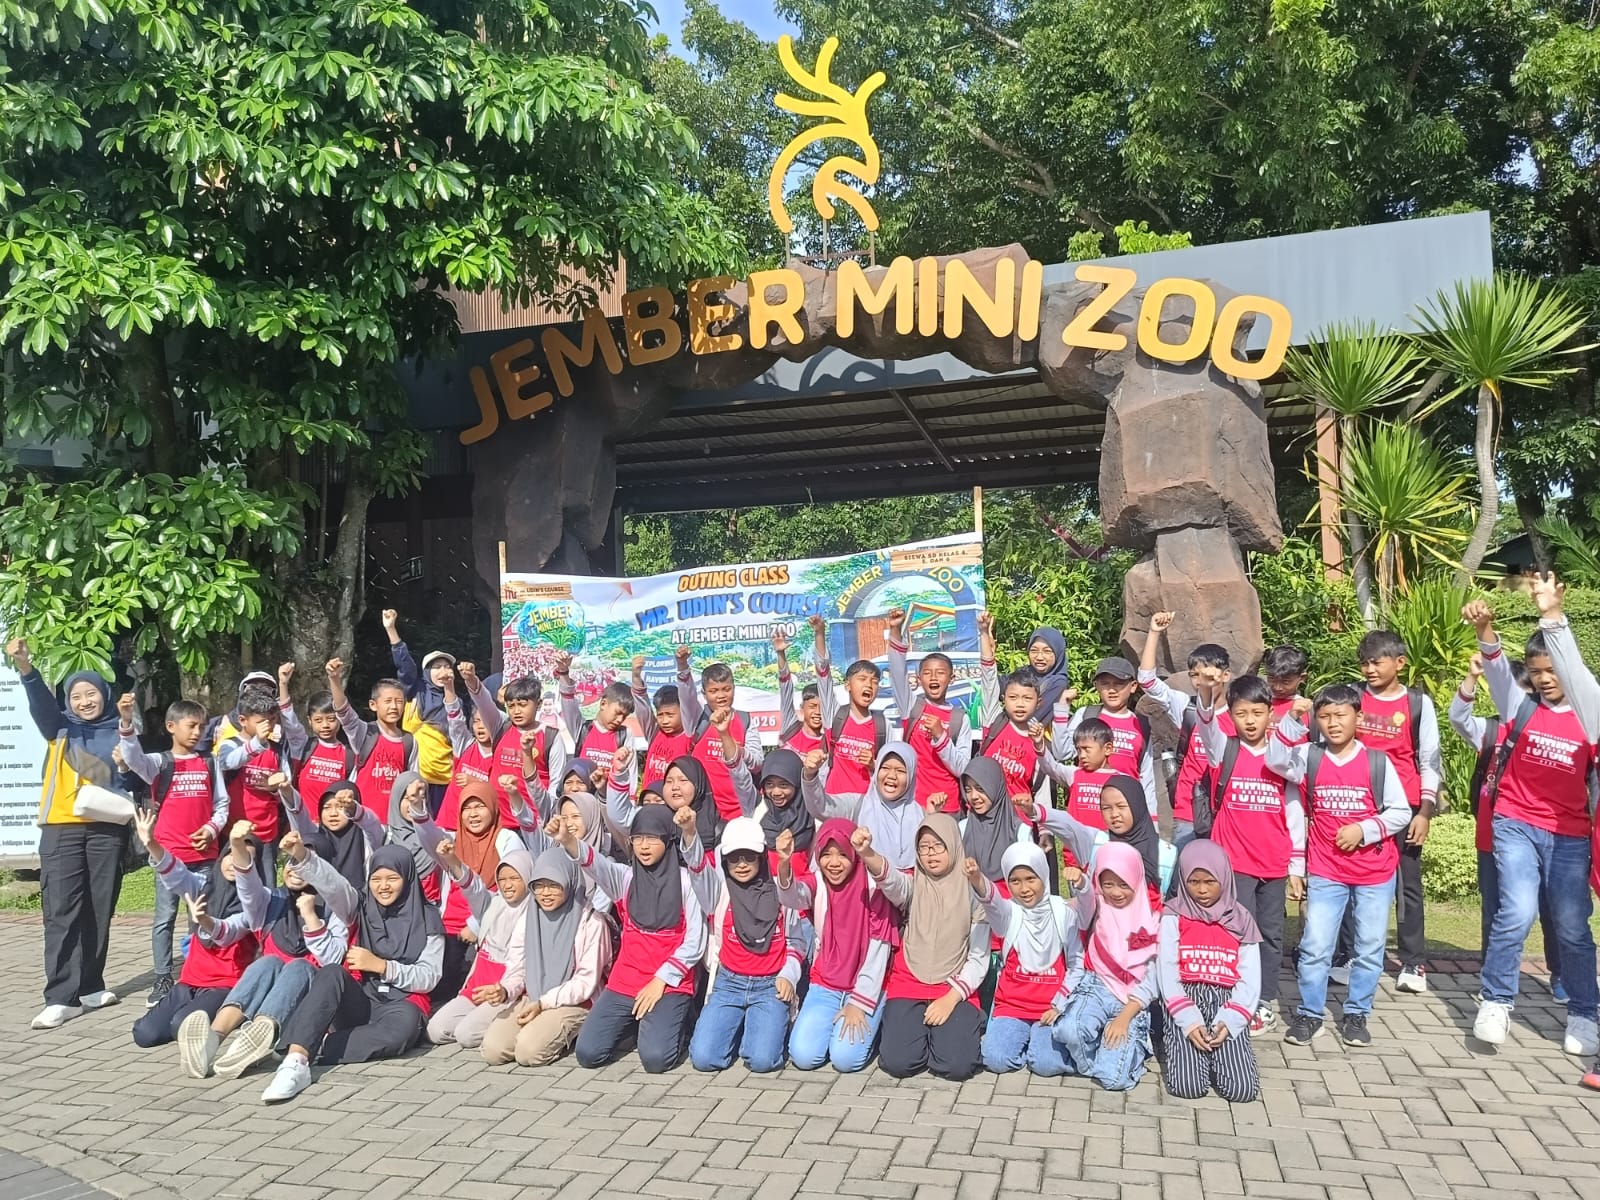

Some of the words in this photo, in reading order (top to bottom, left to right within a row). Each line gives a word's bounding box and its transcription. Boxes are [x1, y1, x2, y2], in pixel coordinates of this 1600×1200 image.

[459, 268, 806, 446] JEMBER
[836, 256, 1043, 341] MINI
[1062, 265, 1293, 380] ZOO
[678, 569, 737, 593] OUTING
[740, 565, 790, 587] CLASS
[836, 564, 883, 615] JEMBER
[928, 566, 964, 592] ZOO
[528, 606, 572, 626] JEMBER
[635, 605, 674, 632] MR.
[677, 592, 744, 620] UDIN'S
[748, 591, 833, 617] COURSE
[672, 629, 690, 645] AT
[689, 626, 736, 643] JEMBER
[738, 624, 767, 640] MINI
[769, 621, 797, 638] ZOO
[752, 716, 776, 727] 026
